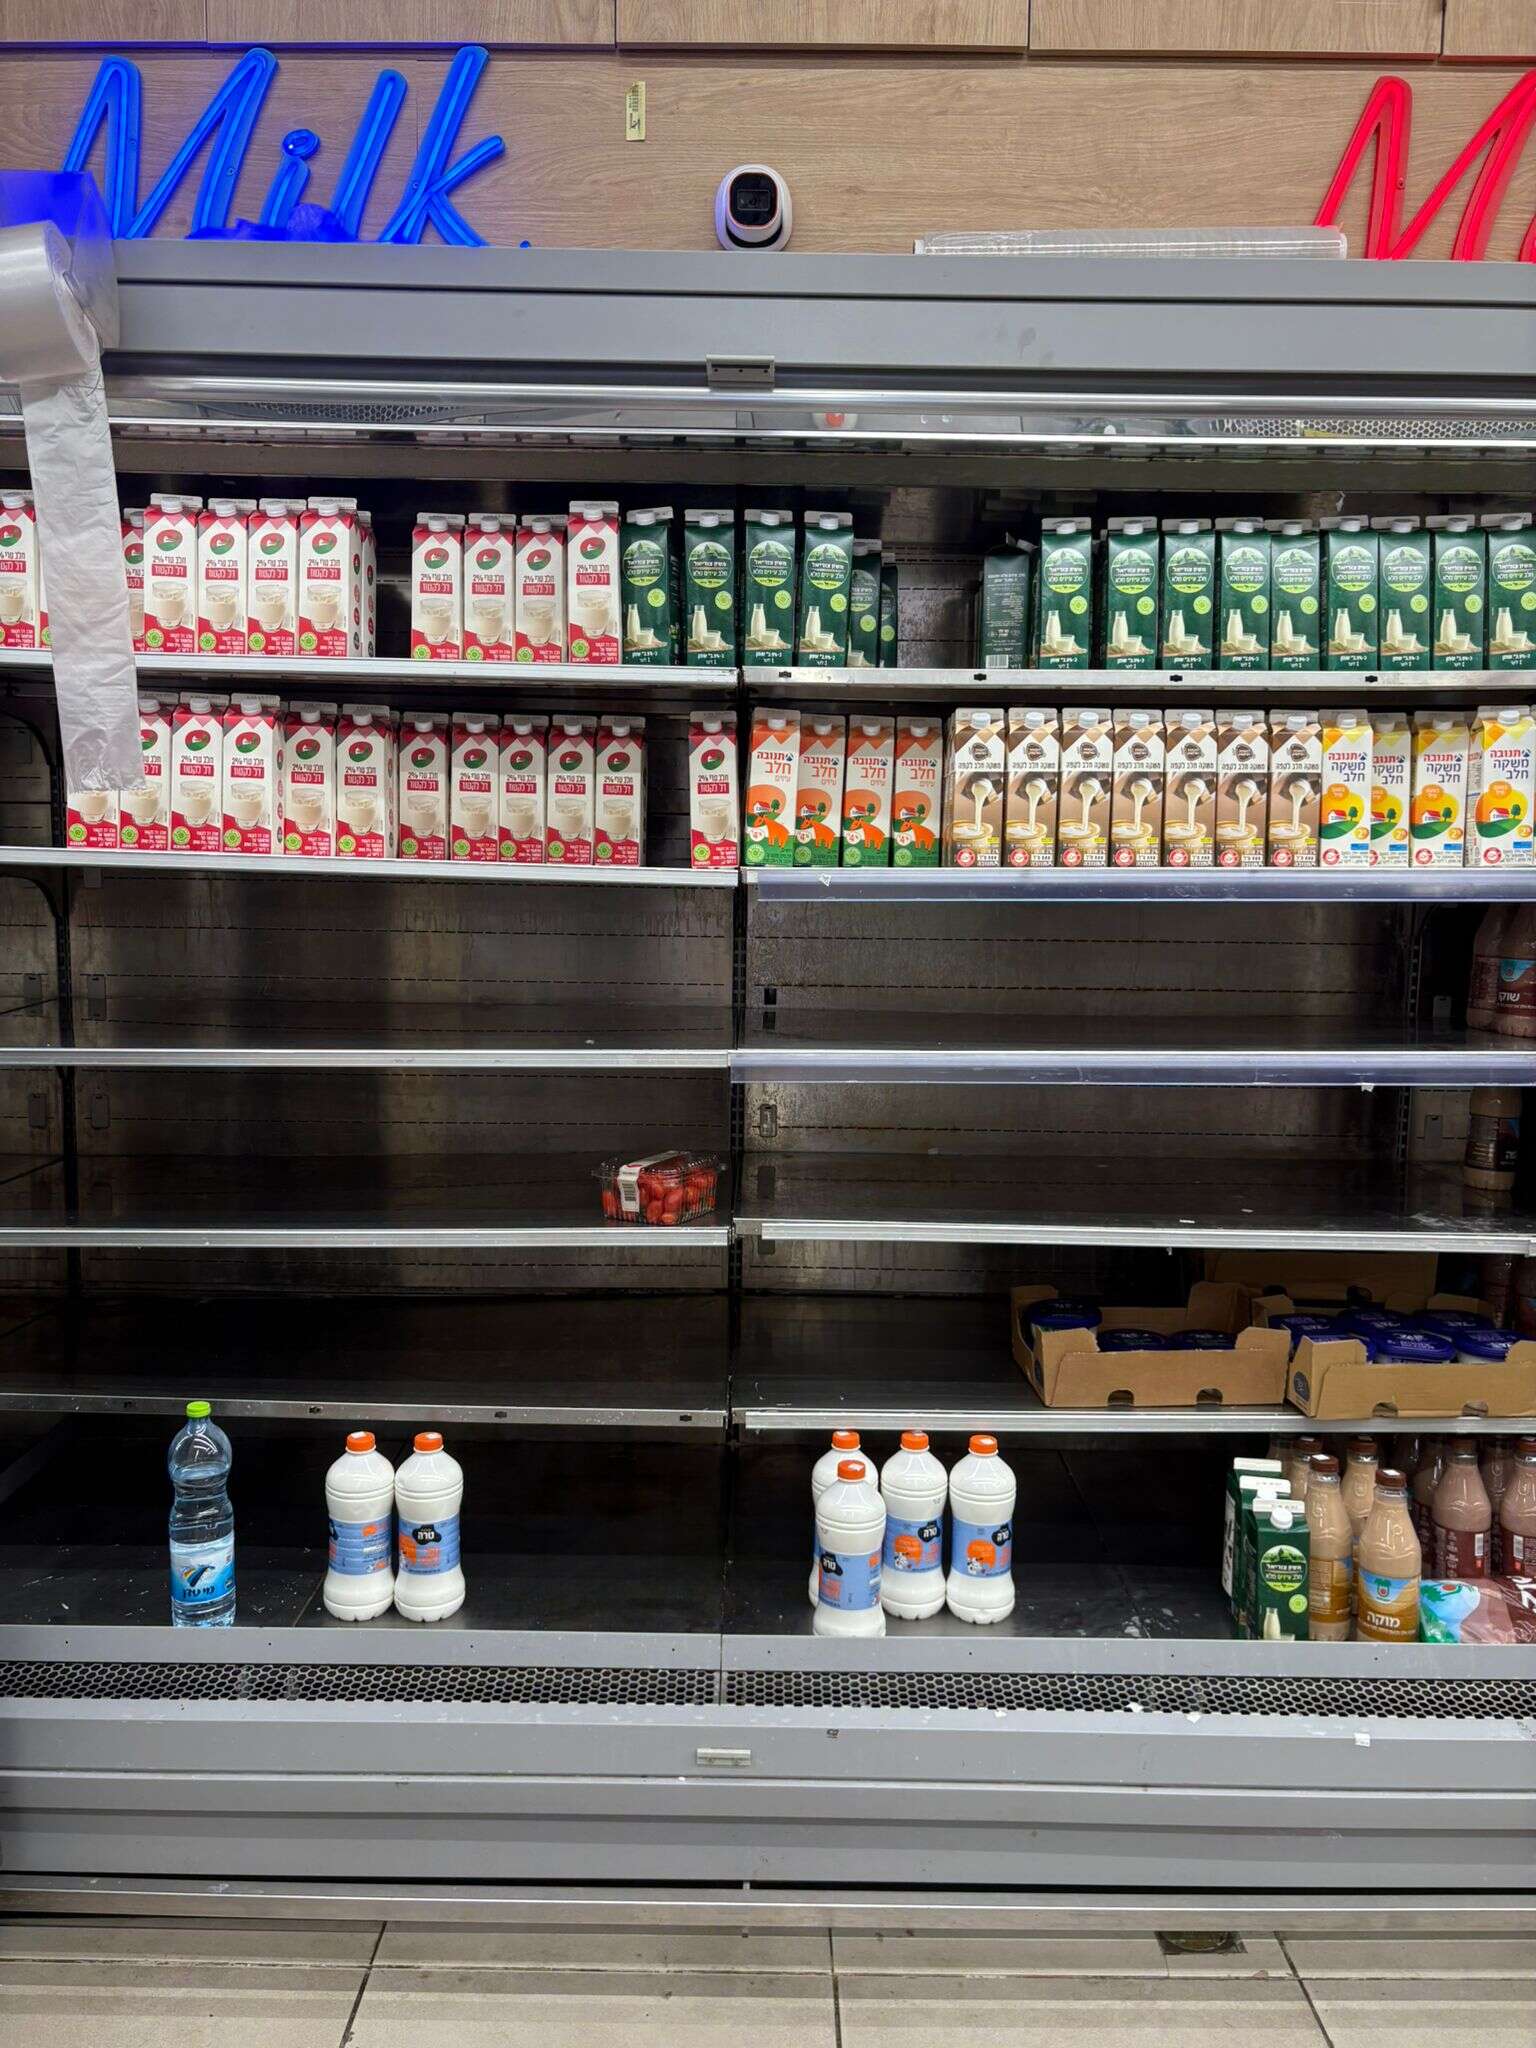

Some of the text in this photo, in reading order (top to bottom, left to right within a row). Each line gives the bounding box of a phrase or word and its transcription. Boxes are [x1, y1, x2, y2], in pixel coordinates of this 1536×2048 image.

[63, 45, 505, 247] Milk
[757, 752, 784, 760] תנובה
[804, 756, 830, 765] תנובה
[1329, 752, 1357, 760] תנובה
[765, 761, 791, 774] חלב
[852, 758, 879, 766] תנובה
[1332, 762, 1365, 773] משקה
[1493, 759, 1529, 771] משקה
[811, 765, 837, 778] חלב
[861, 766, 886, 779] חלב
[910, 767, 935, 779] חלב
[1427, 763, 1461, 774] משקה
[1506, 769, 1529, 779] חלב
[1344, 772, 1365, 782] חלב
[1382, 774, 1403, 784] חלב
[1438, 773, 1460, 783] חלב
[1366, 1611, 1400, 1628] מוקה
